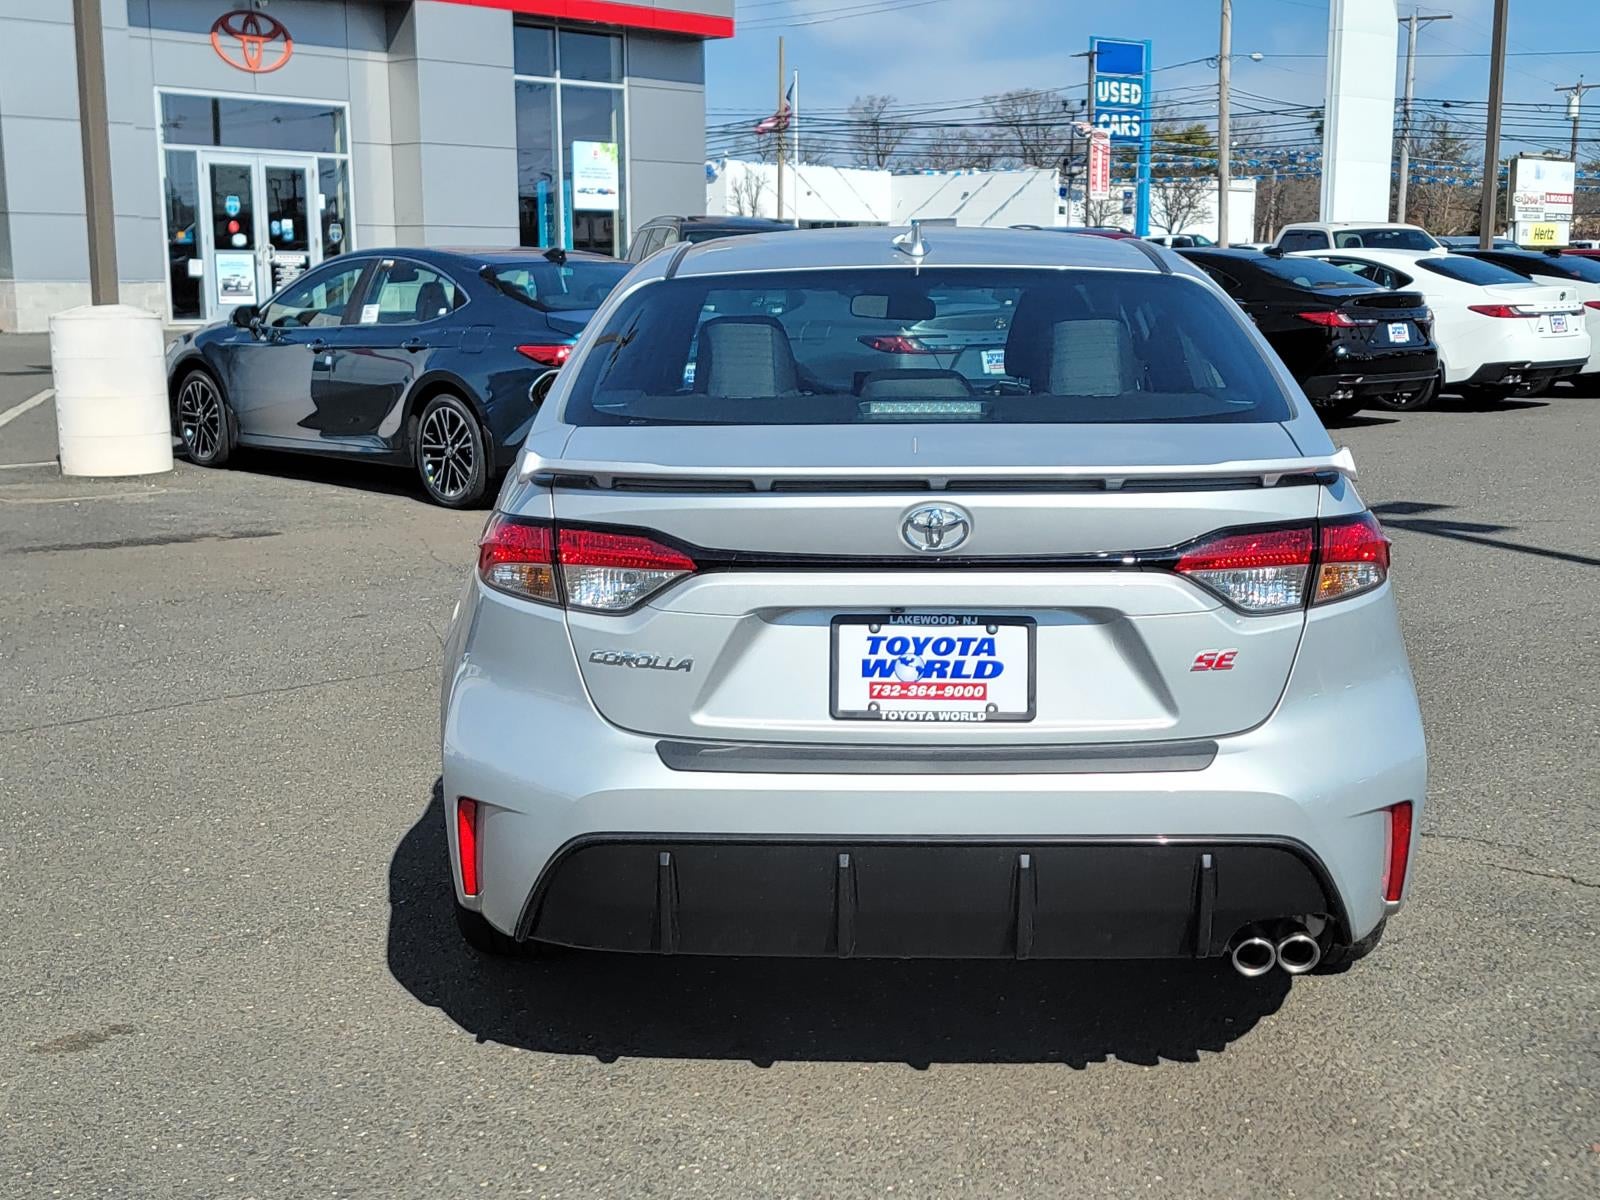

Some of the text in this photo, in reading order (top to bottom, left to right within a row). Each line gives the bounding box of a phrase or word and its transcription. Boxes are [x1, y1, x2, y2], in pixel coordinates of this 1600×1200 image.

[1097, 81, 1142, 105] USED
[1098, 114, 1141, 137] CARS
[1534, 227, 1554, 240] Hertz
[889, 615, 978, 625] LAKEWOOD, NJ
[866, 636, 996, 656] TOYOTA
[589, 648, 695, 673] COROLLA
[861, 656, 1005, 682] WORLD
[1190, 648, 1239, 672] SE
[871, 684, 985, 698] 732-364-9000
[880, 710, 987, 721] TOYOTA WORLD
